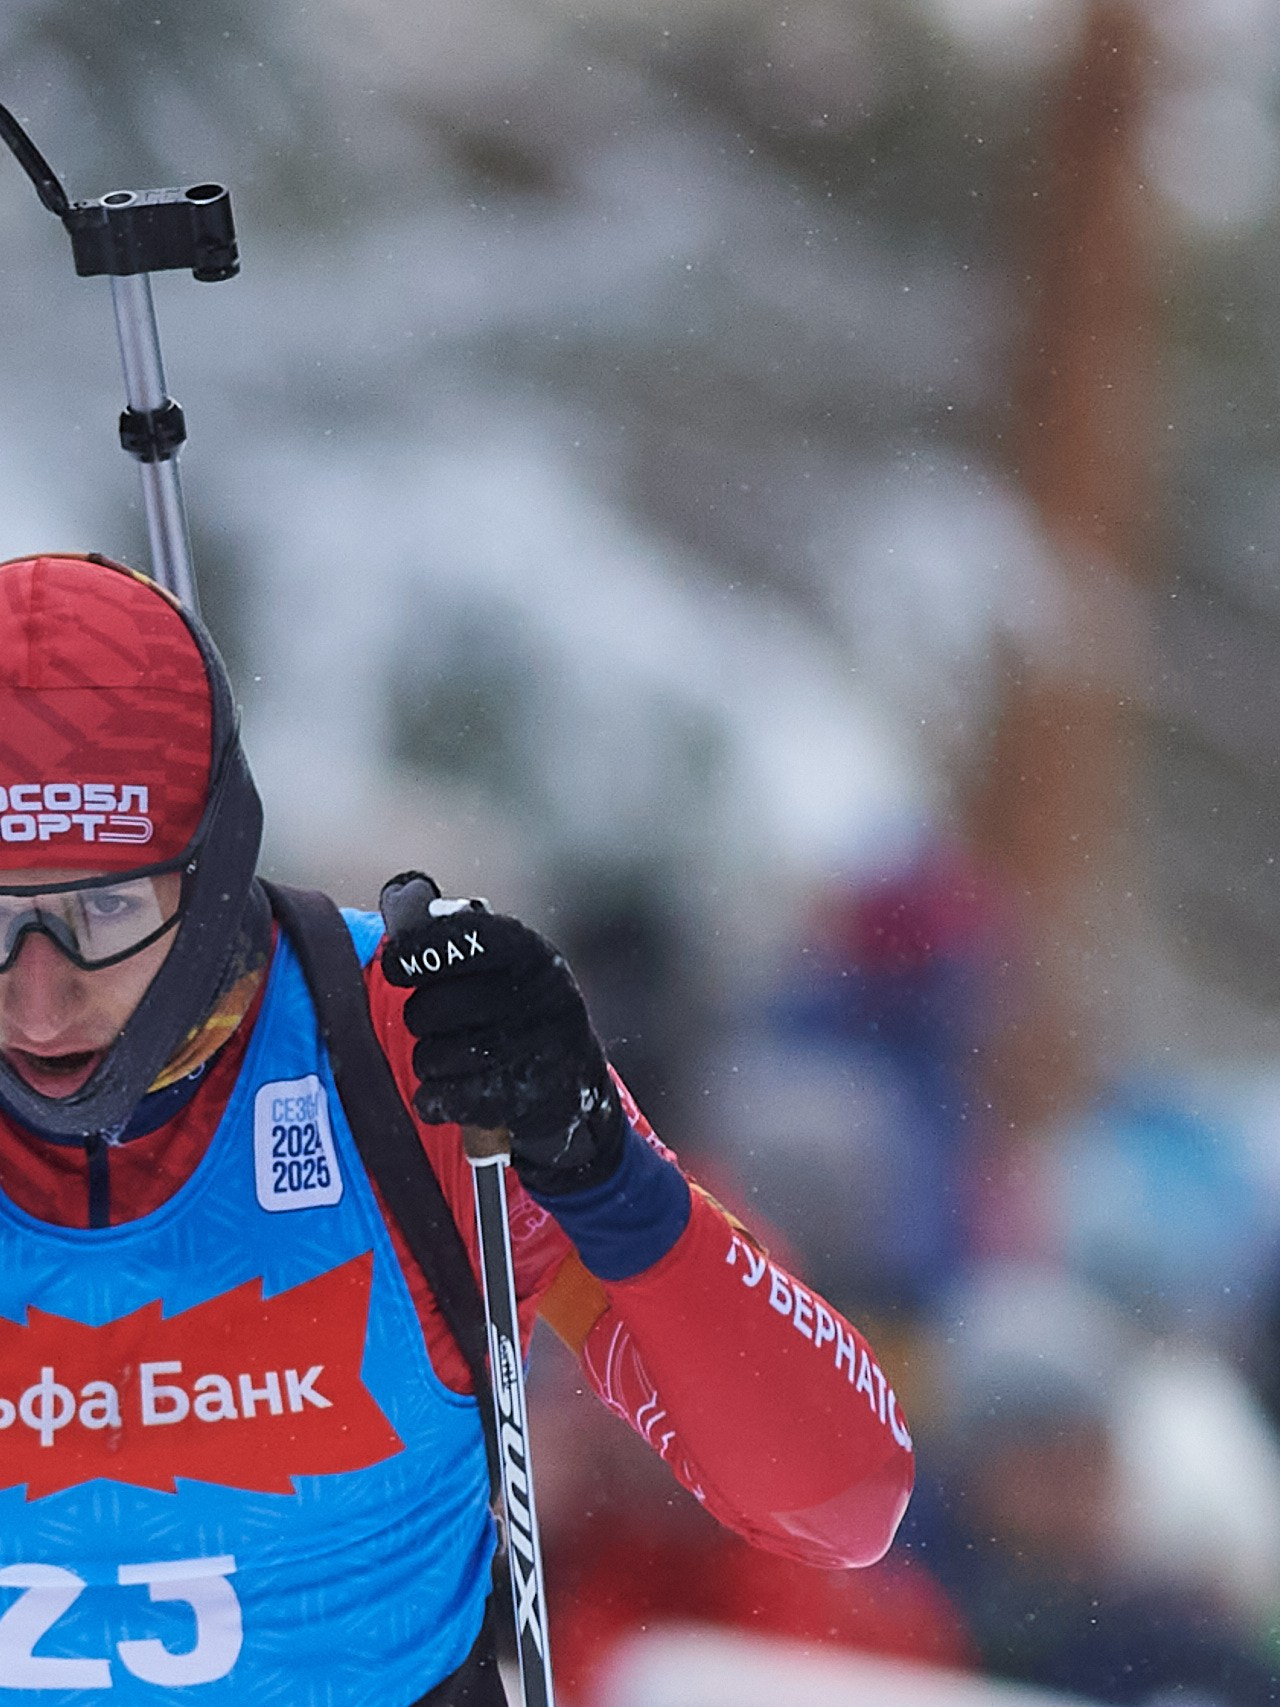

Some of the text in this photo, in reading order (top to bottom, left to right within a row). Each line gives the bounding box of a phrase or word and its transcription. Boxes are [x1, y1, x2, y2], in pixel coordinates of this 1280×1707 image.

[399, 931, 485, 977] MOAX
[272, 1156, 331, 1194] 2025
[140, 1360, 333, 1427] Банк
